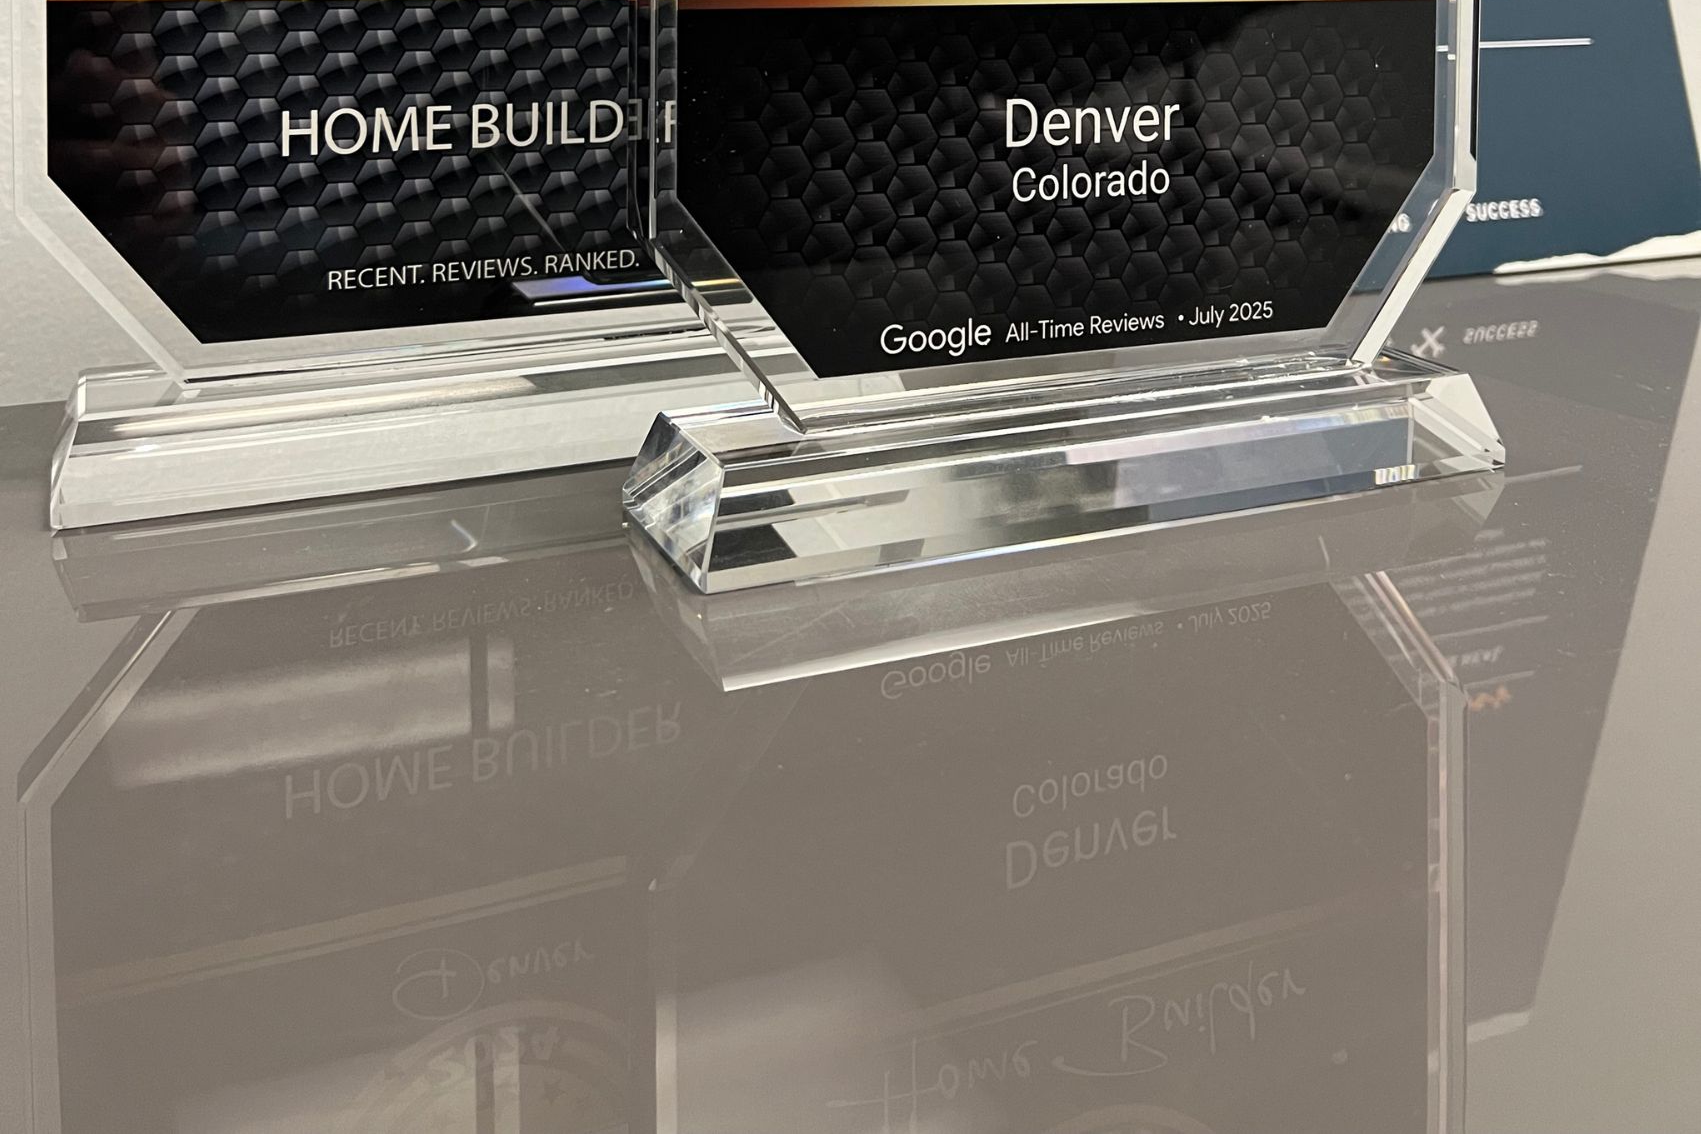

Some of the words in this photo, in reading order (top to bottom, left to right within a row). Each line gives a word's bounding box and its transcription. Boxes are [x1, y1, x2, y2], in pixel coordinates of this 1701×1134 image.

[281, 104, 453, 157] HOME
[1005, 98, 1180, 148] Denver
[1011, 159, 1171, 202] Colorado
[1466, 198, 1544, 223] SUCCESS
[327, 264, 425, 291] RECENT.
[432, 256, 539, 283] REVIEWS.
[545, 249, 640, 274] RANKED.
[879, 317, 993, 357] Google
[1005, 319, 1085, 344] All-Time
[1089, 313, 1166, 335] Reviews
[1188, 304, 1225, 329] July
[1228, 300, 1274, 323] 2025
